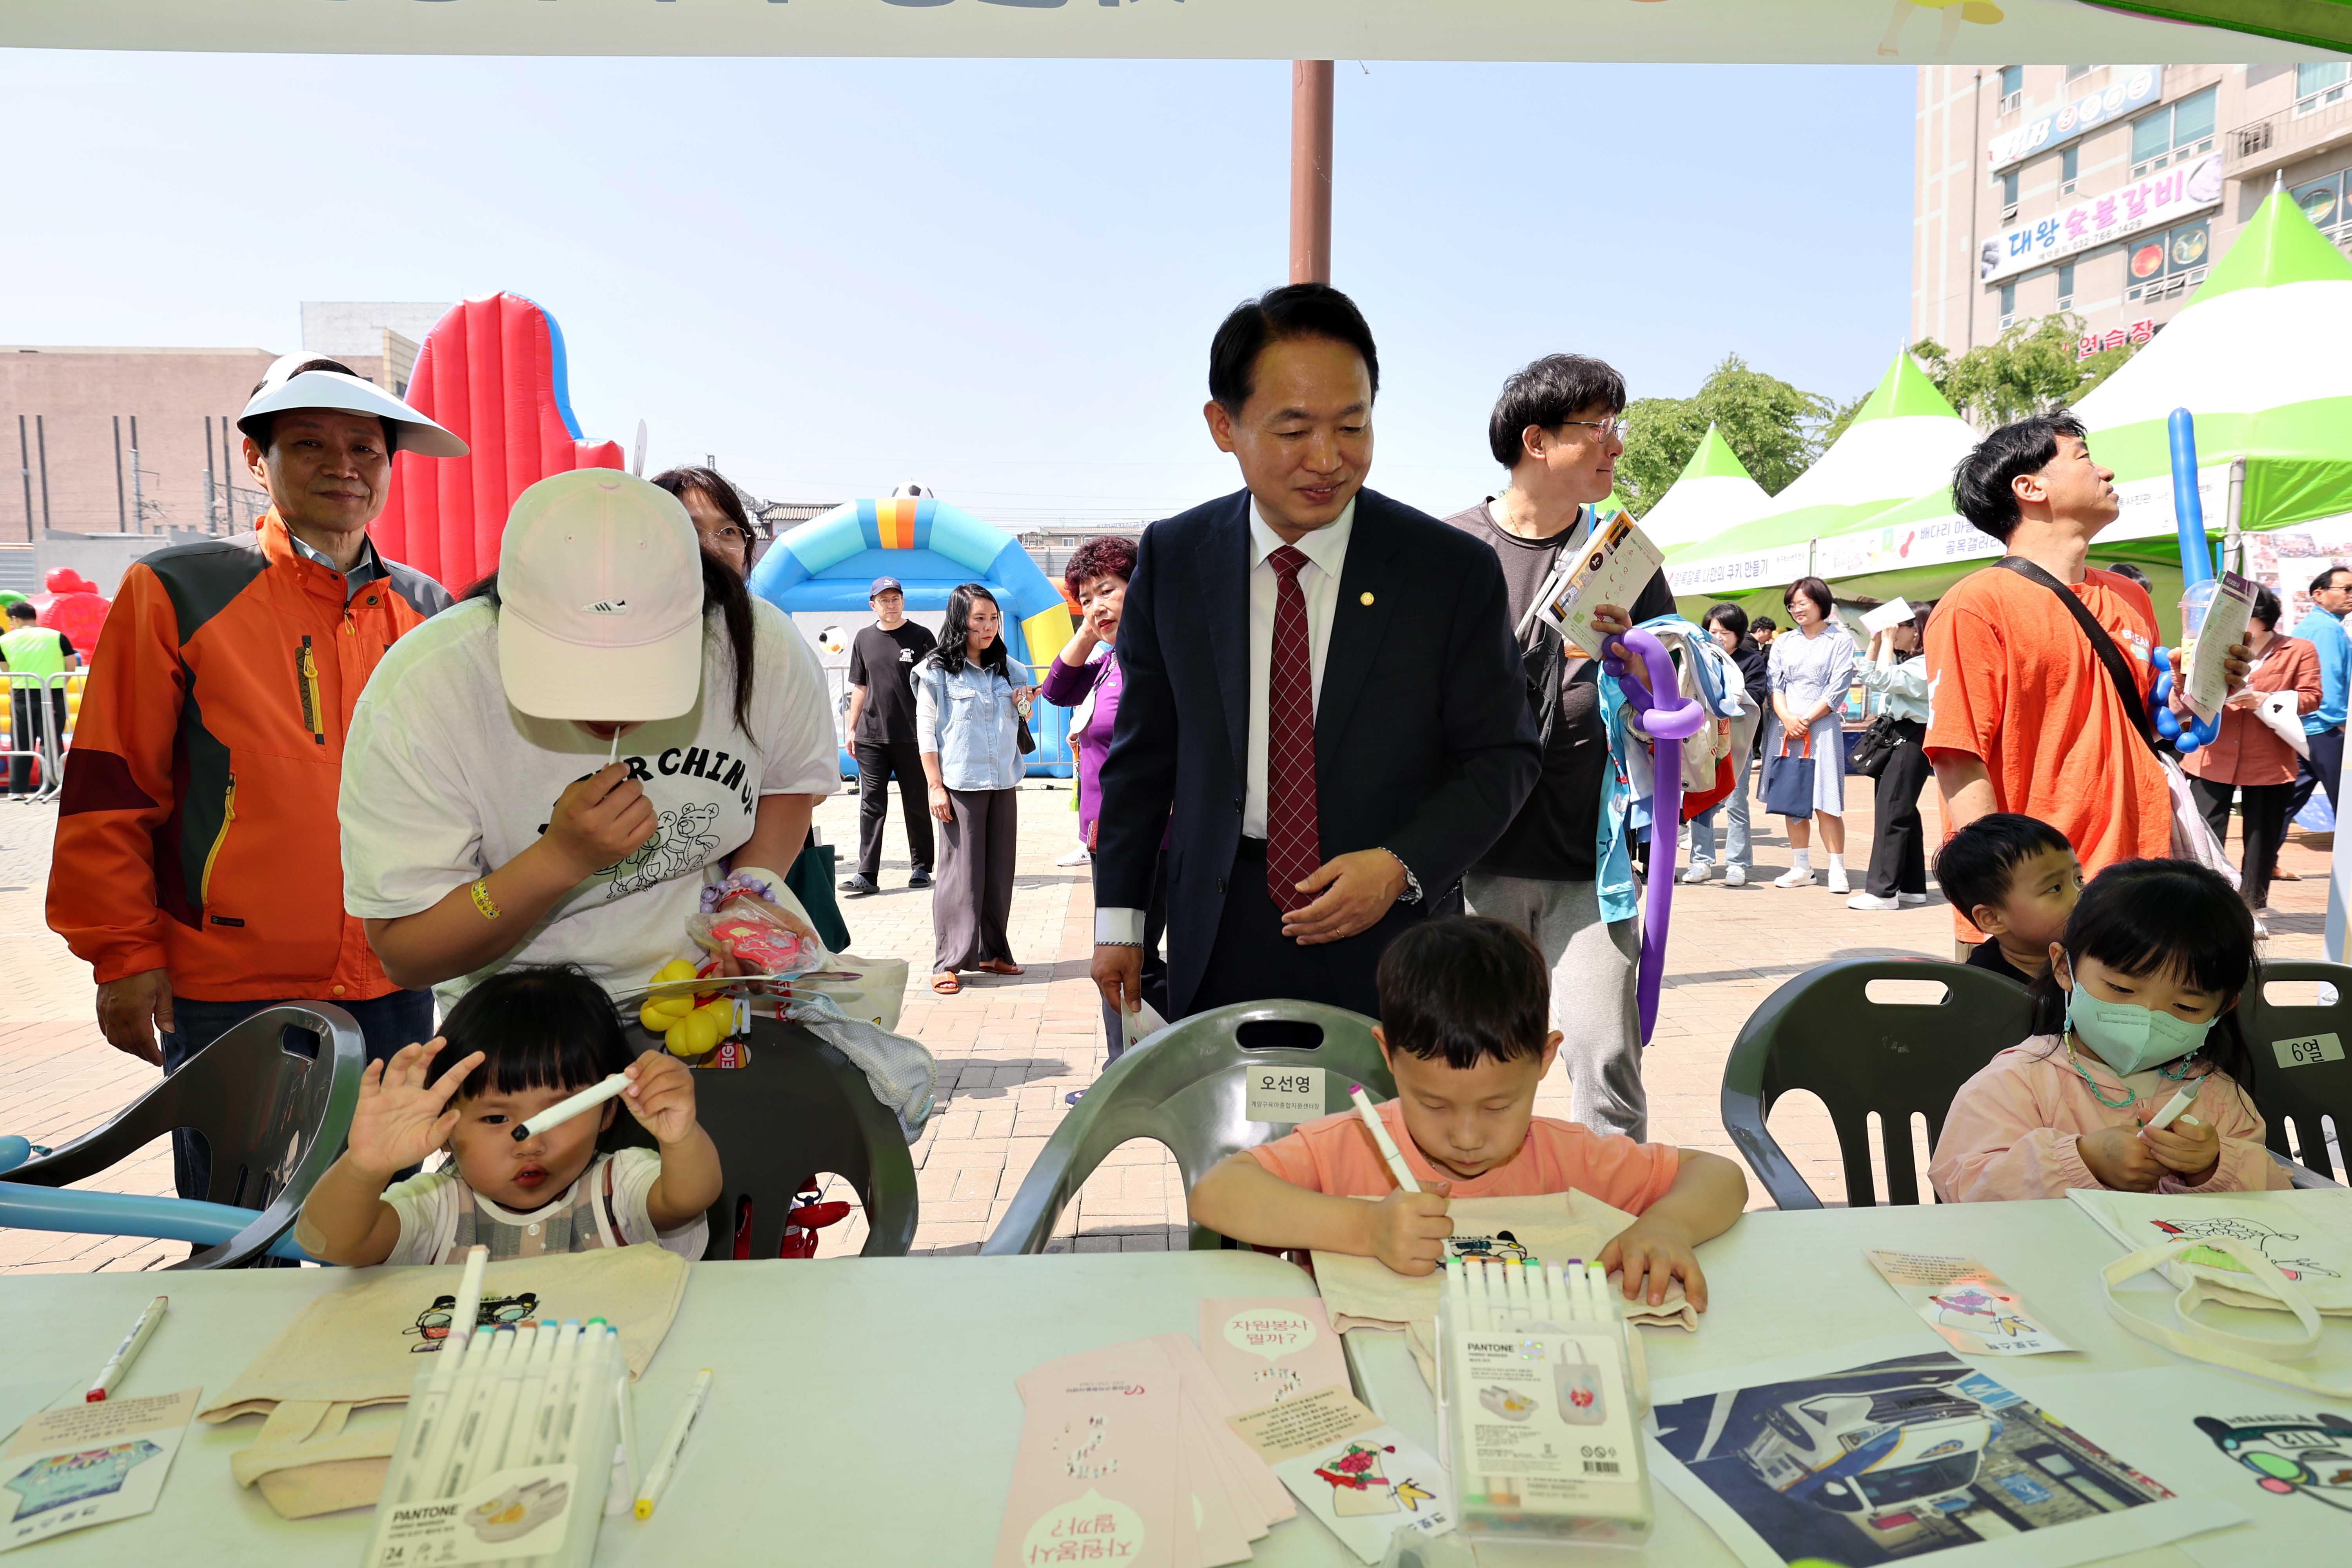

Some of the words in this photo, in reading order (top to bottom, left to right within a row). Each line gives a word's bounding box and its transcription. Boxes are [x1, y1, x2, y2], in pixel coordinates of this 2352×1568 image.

[1920, 523, 1950, 540] 배다리
[1673, 569, 1700, 587] 알록달록
[1702, 565, 1724, 583] 나만의
[1727, 563, 1742, 579] 쿠키
[1745, 558, 1768, 578] 만들기
[658, 746, 746, 791] CHIN
[2292, 1039, 2325, 1062] 6열
[1260, 1076, 1310, 1093] 오선영
[1251, 1101, 1319, 1110] 계양구육아종합지원센터장
[1232, 1320, 1309, 1332] 자원봉사
[1468, 1343, 1514, 1352] PANTONE
[393, 1504, 457, 1522] PANTONE
[1029, 1538, 1132, 1564] 자원봉사
